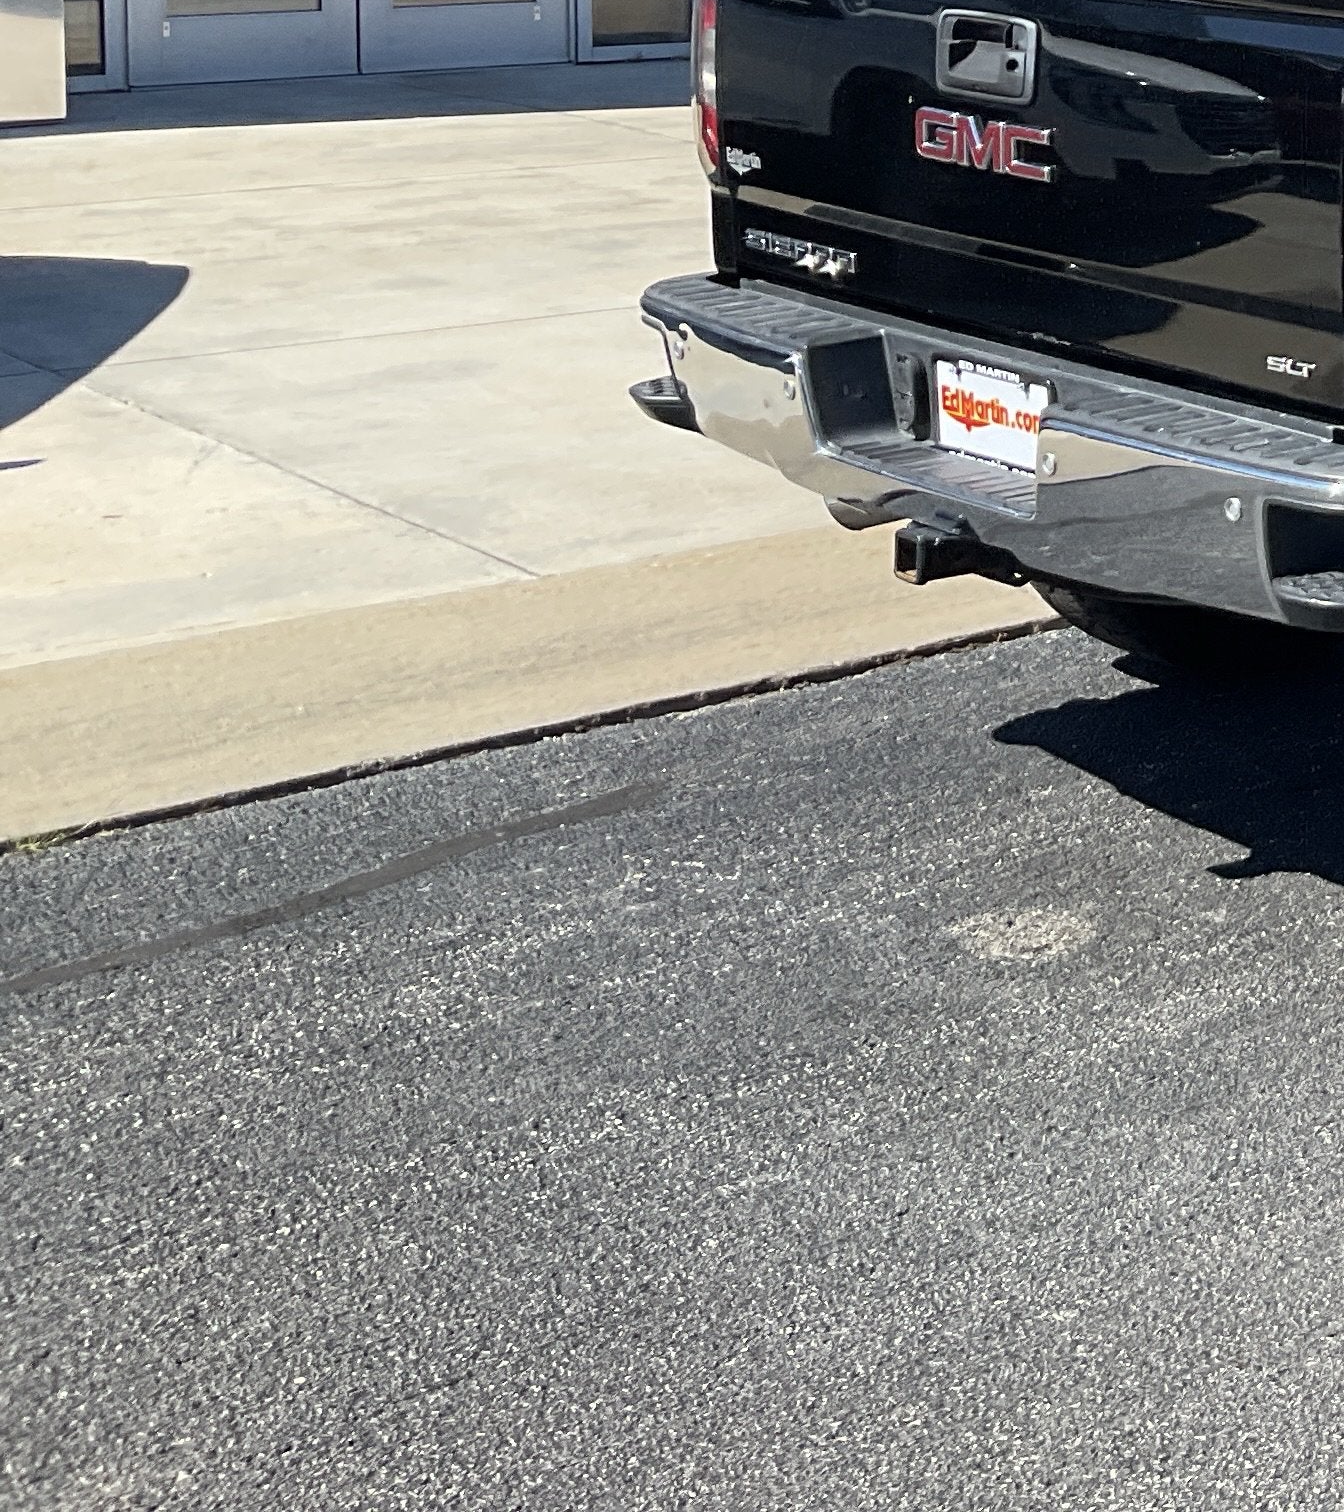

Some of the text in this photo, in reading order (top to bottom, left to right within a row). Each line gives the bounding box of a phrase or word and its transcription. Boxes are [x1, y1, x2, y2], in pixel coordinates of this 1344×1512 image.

[915, 106, 1055, 183] GMC
[958, 359, 1020, 384] ED MARTIN
[1266, 355, 1317, 378] SLT
